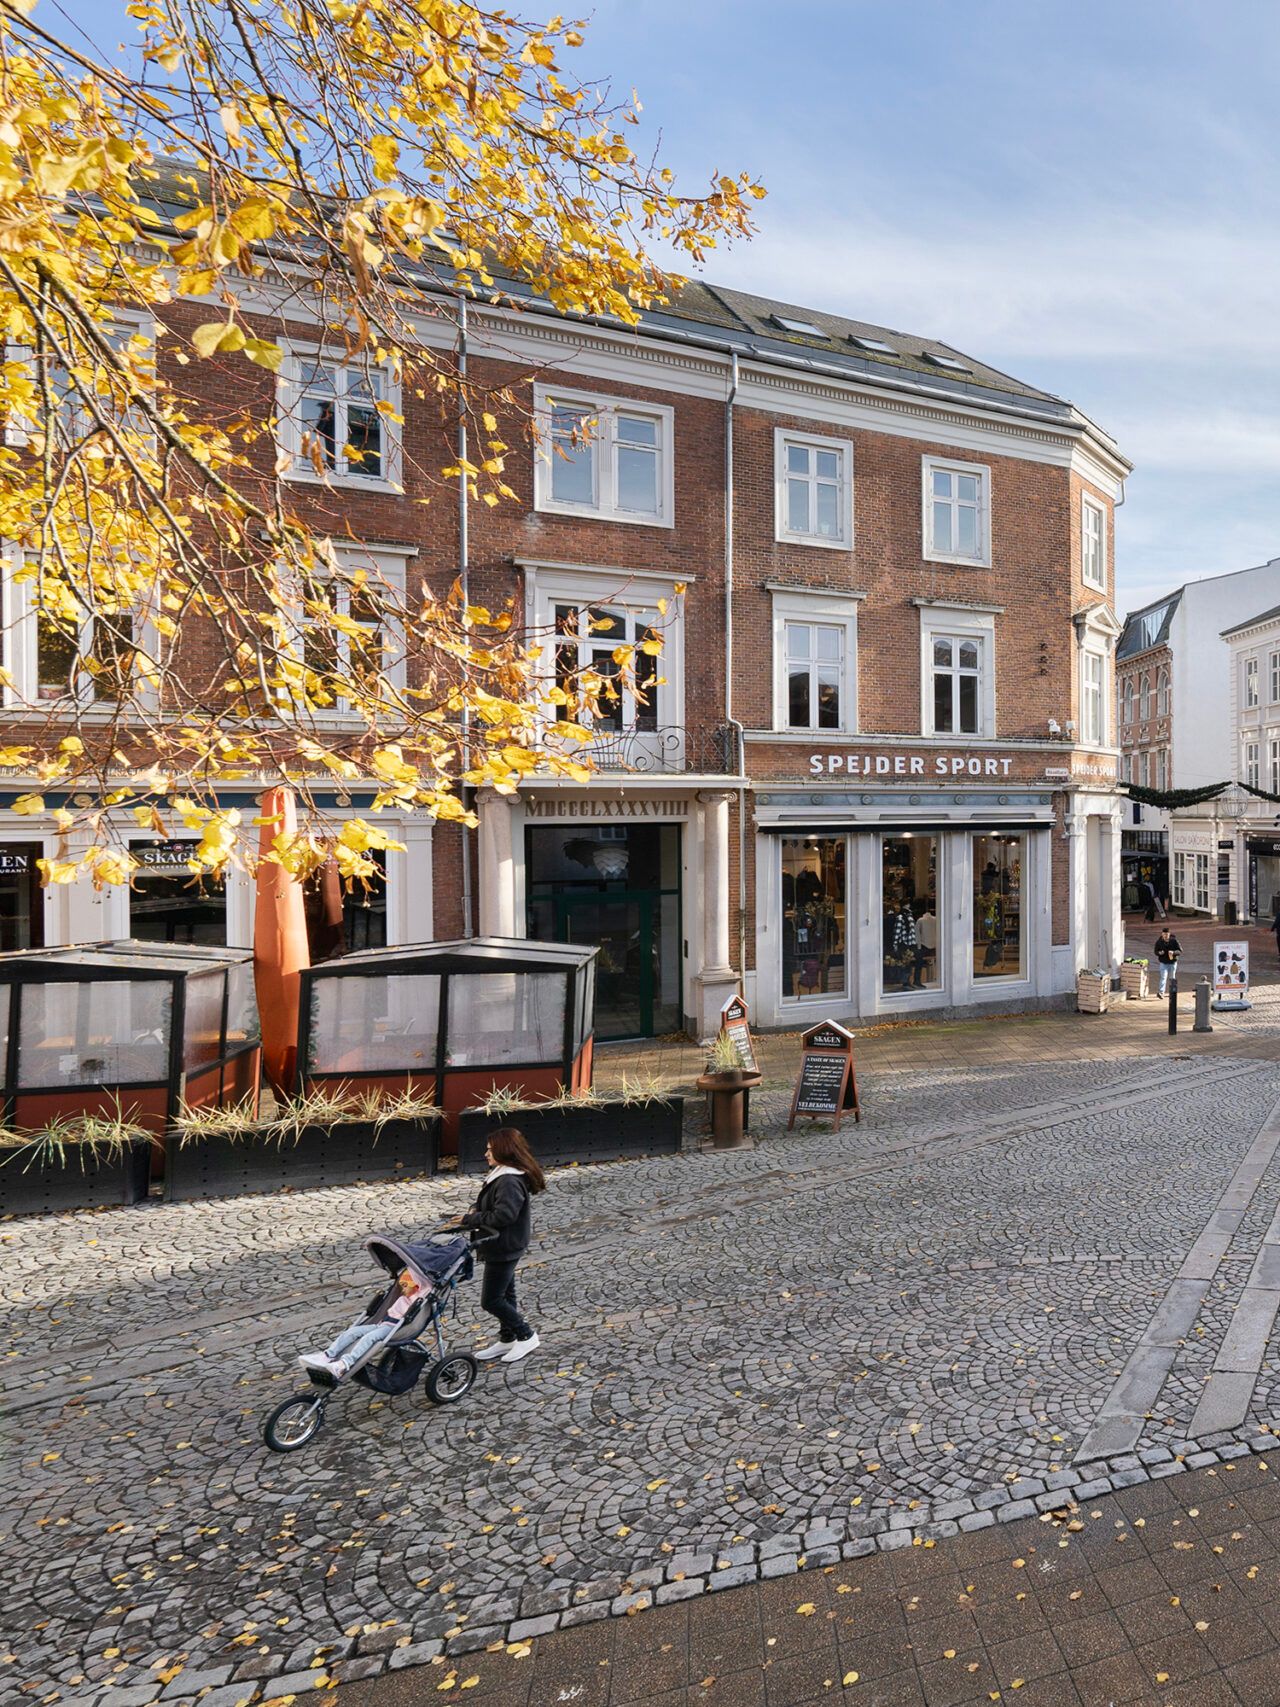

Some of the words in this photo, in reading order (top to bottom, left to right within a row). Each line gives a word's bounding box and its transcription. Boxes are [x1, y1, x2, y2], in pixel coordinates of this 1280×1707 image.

[809, 754, 925, 775] SPEJDER
[935, 757, 1013, 775] SPORT
[813, 1035, 841, 1043] SKAGEN
